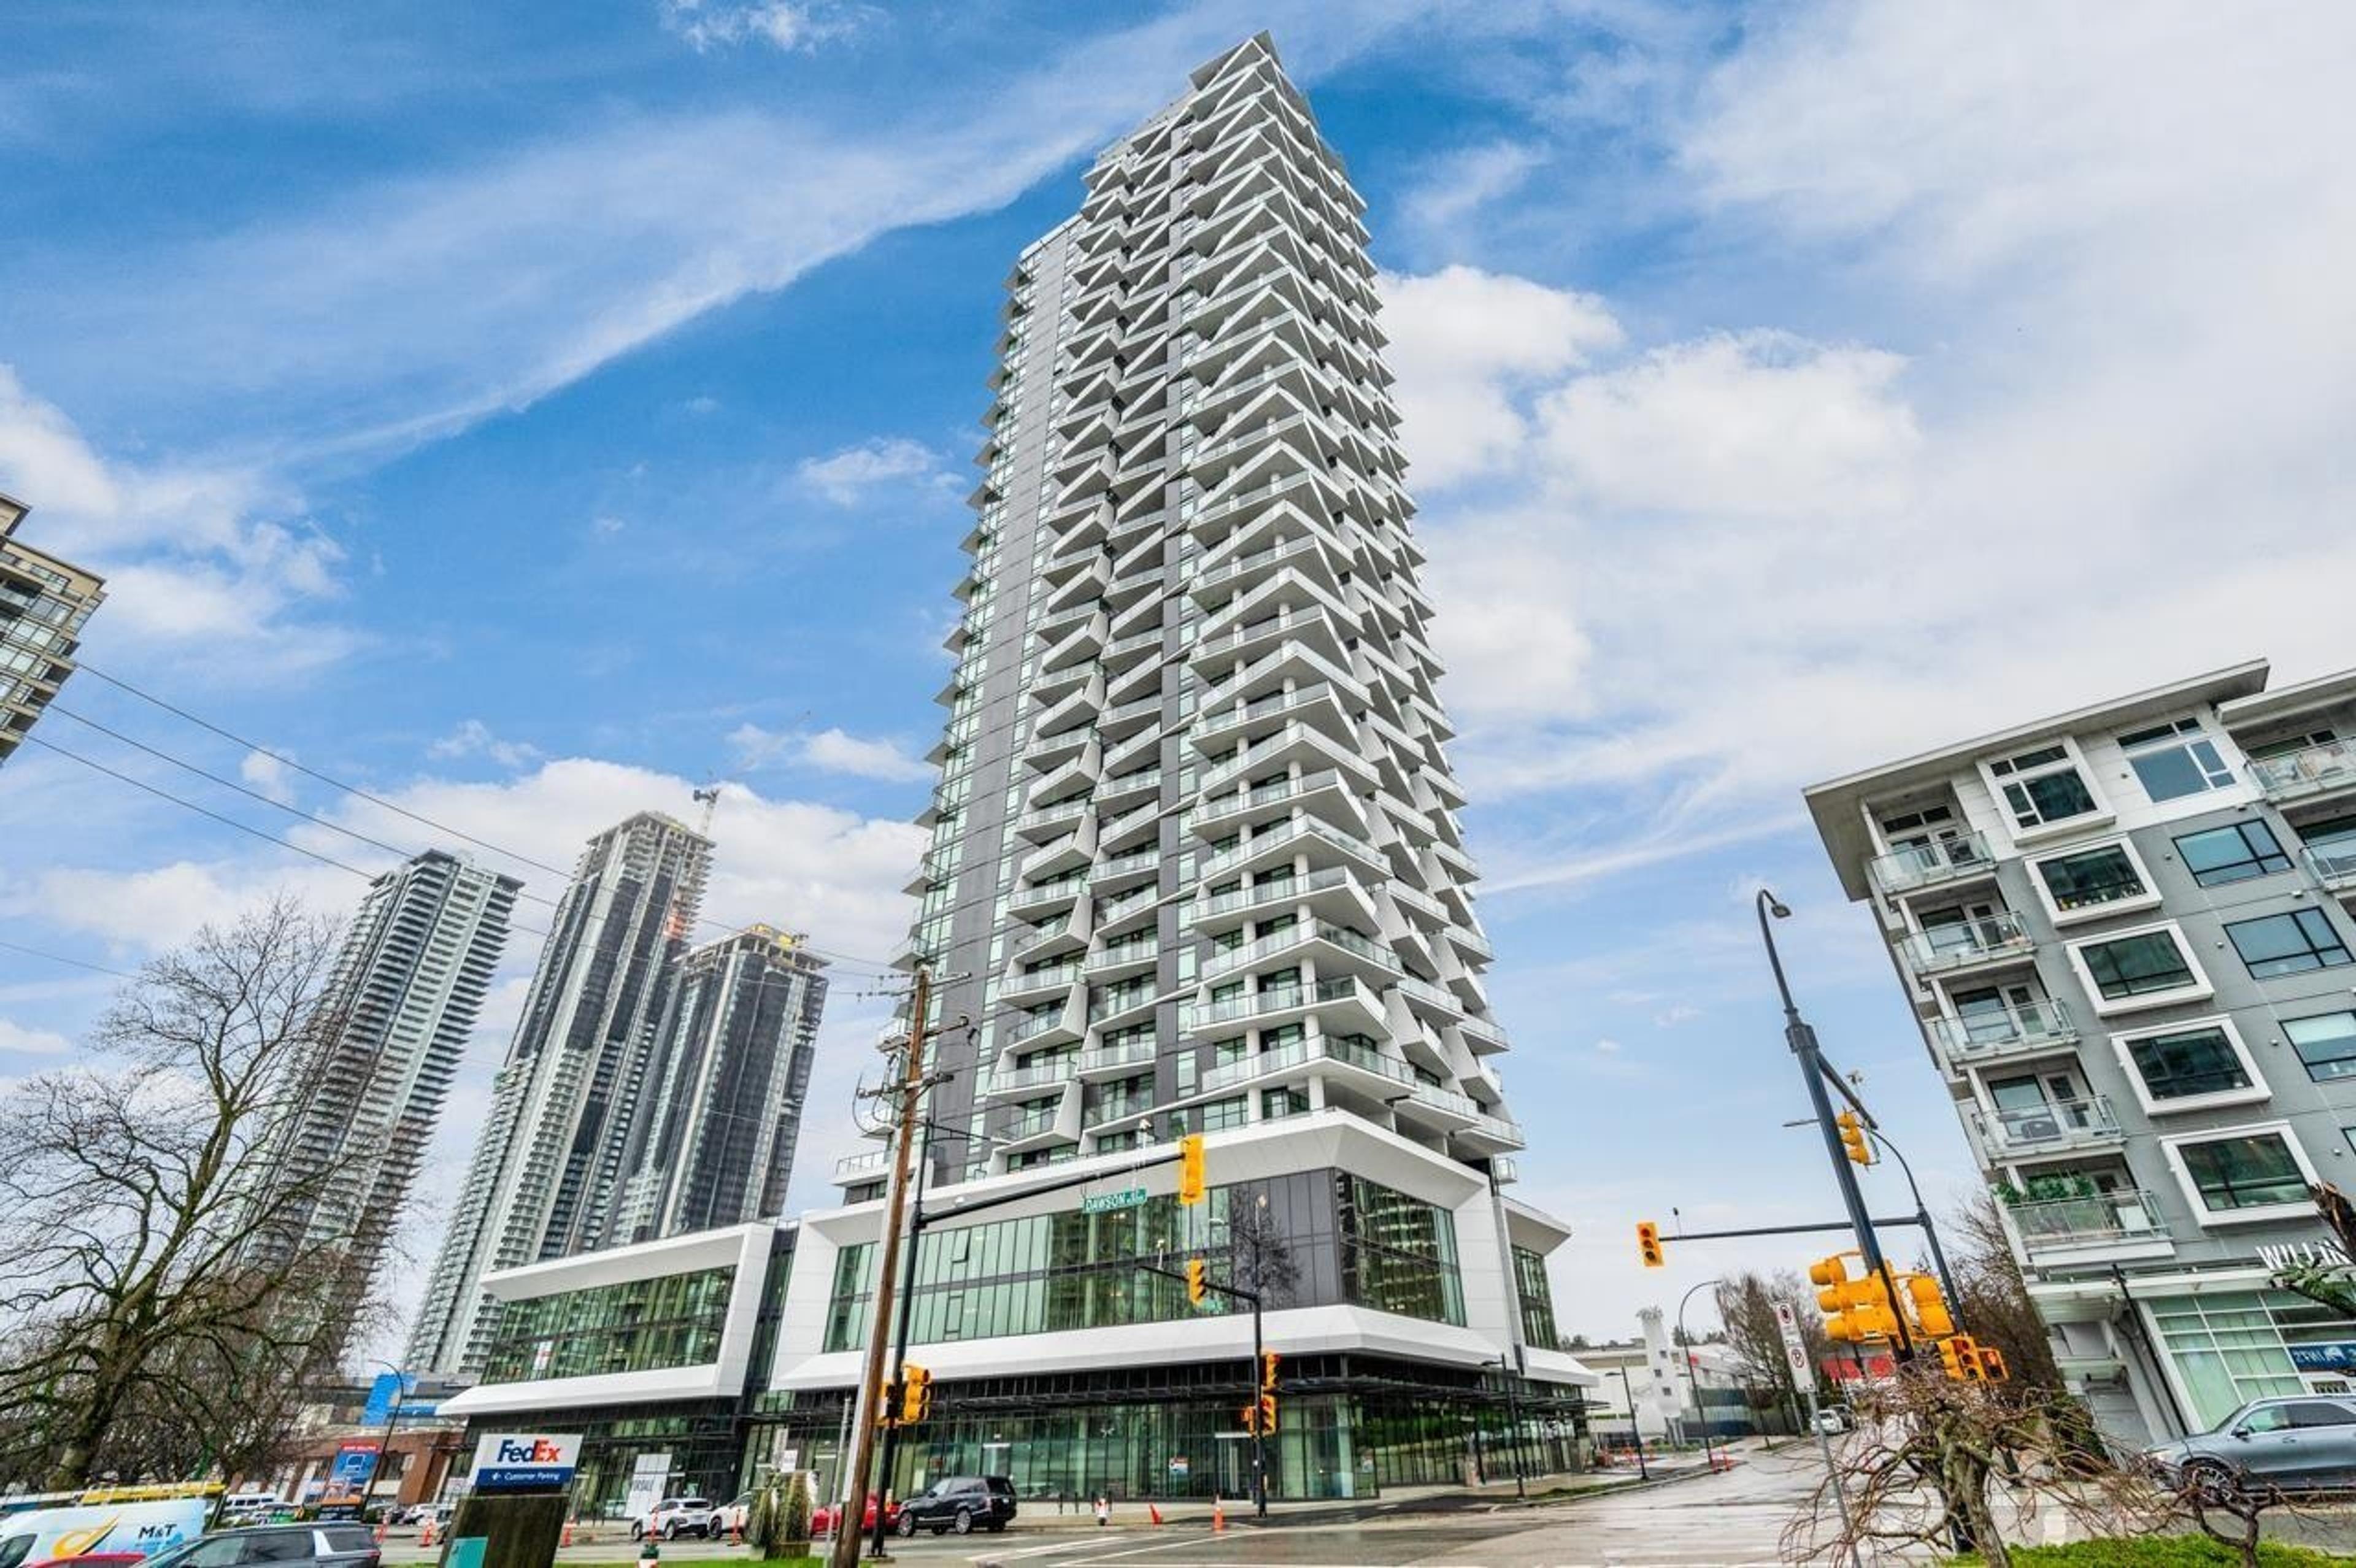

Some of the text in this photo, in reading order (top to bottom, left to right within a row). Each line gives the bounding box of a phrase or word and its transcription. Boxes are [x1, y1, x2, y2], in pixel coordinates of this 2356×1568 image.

[1085, 1192, 1124, 1211] DAWSON
[498, 1440, 561, 1462] FedEx
[138, 1524, 177, 1539] M&T
